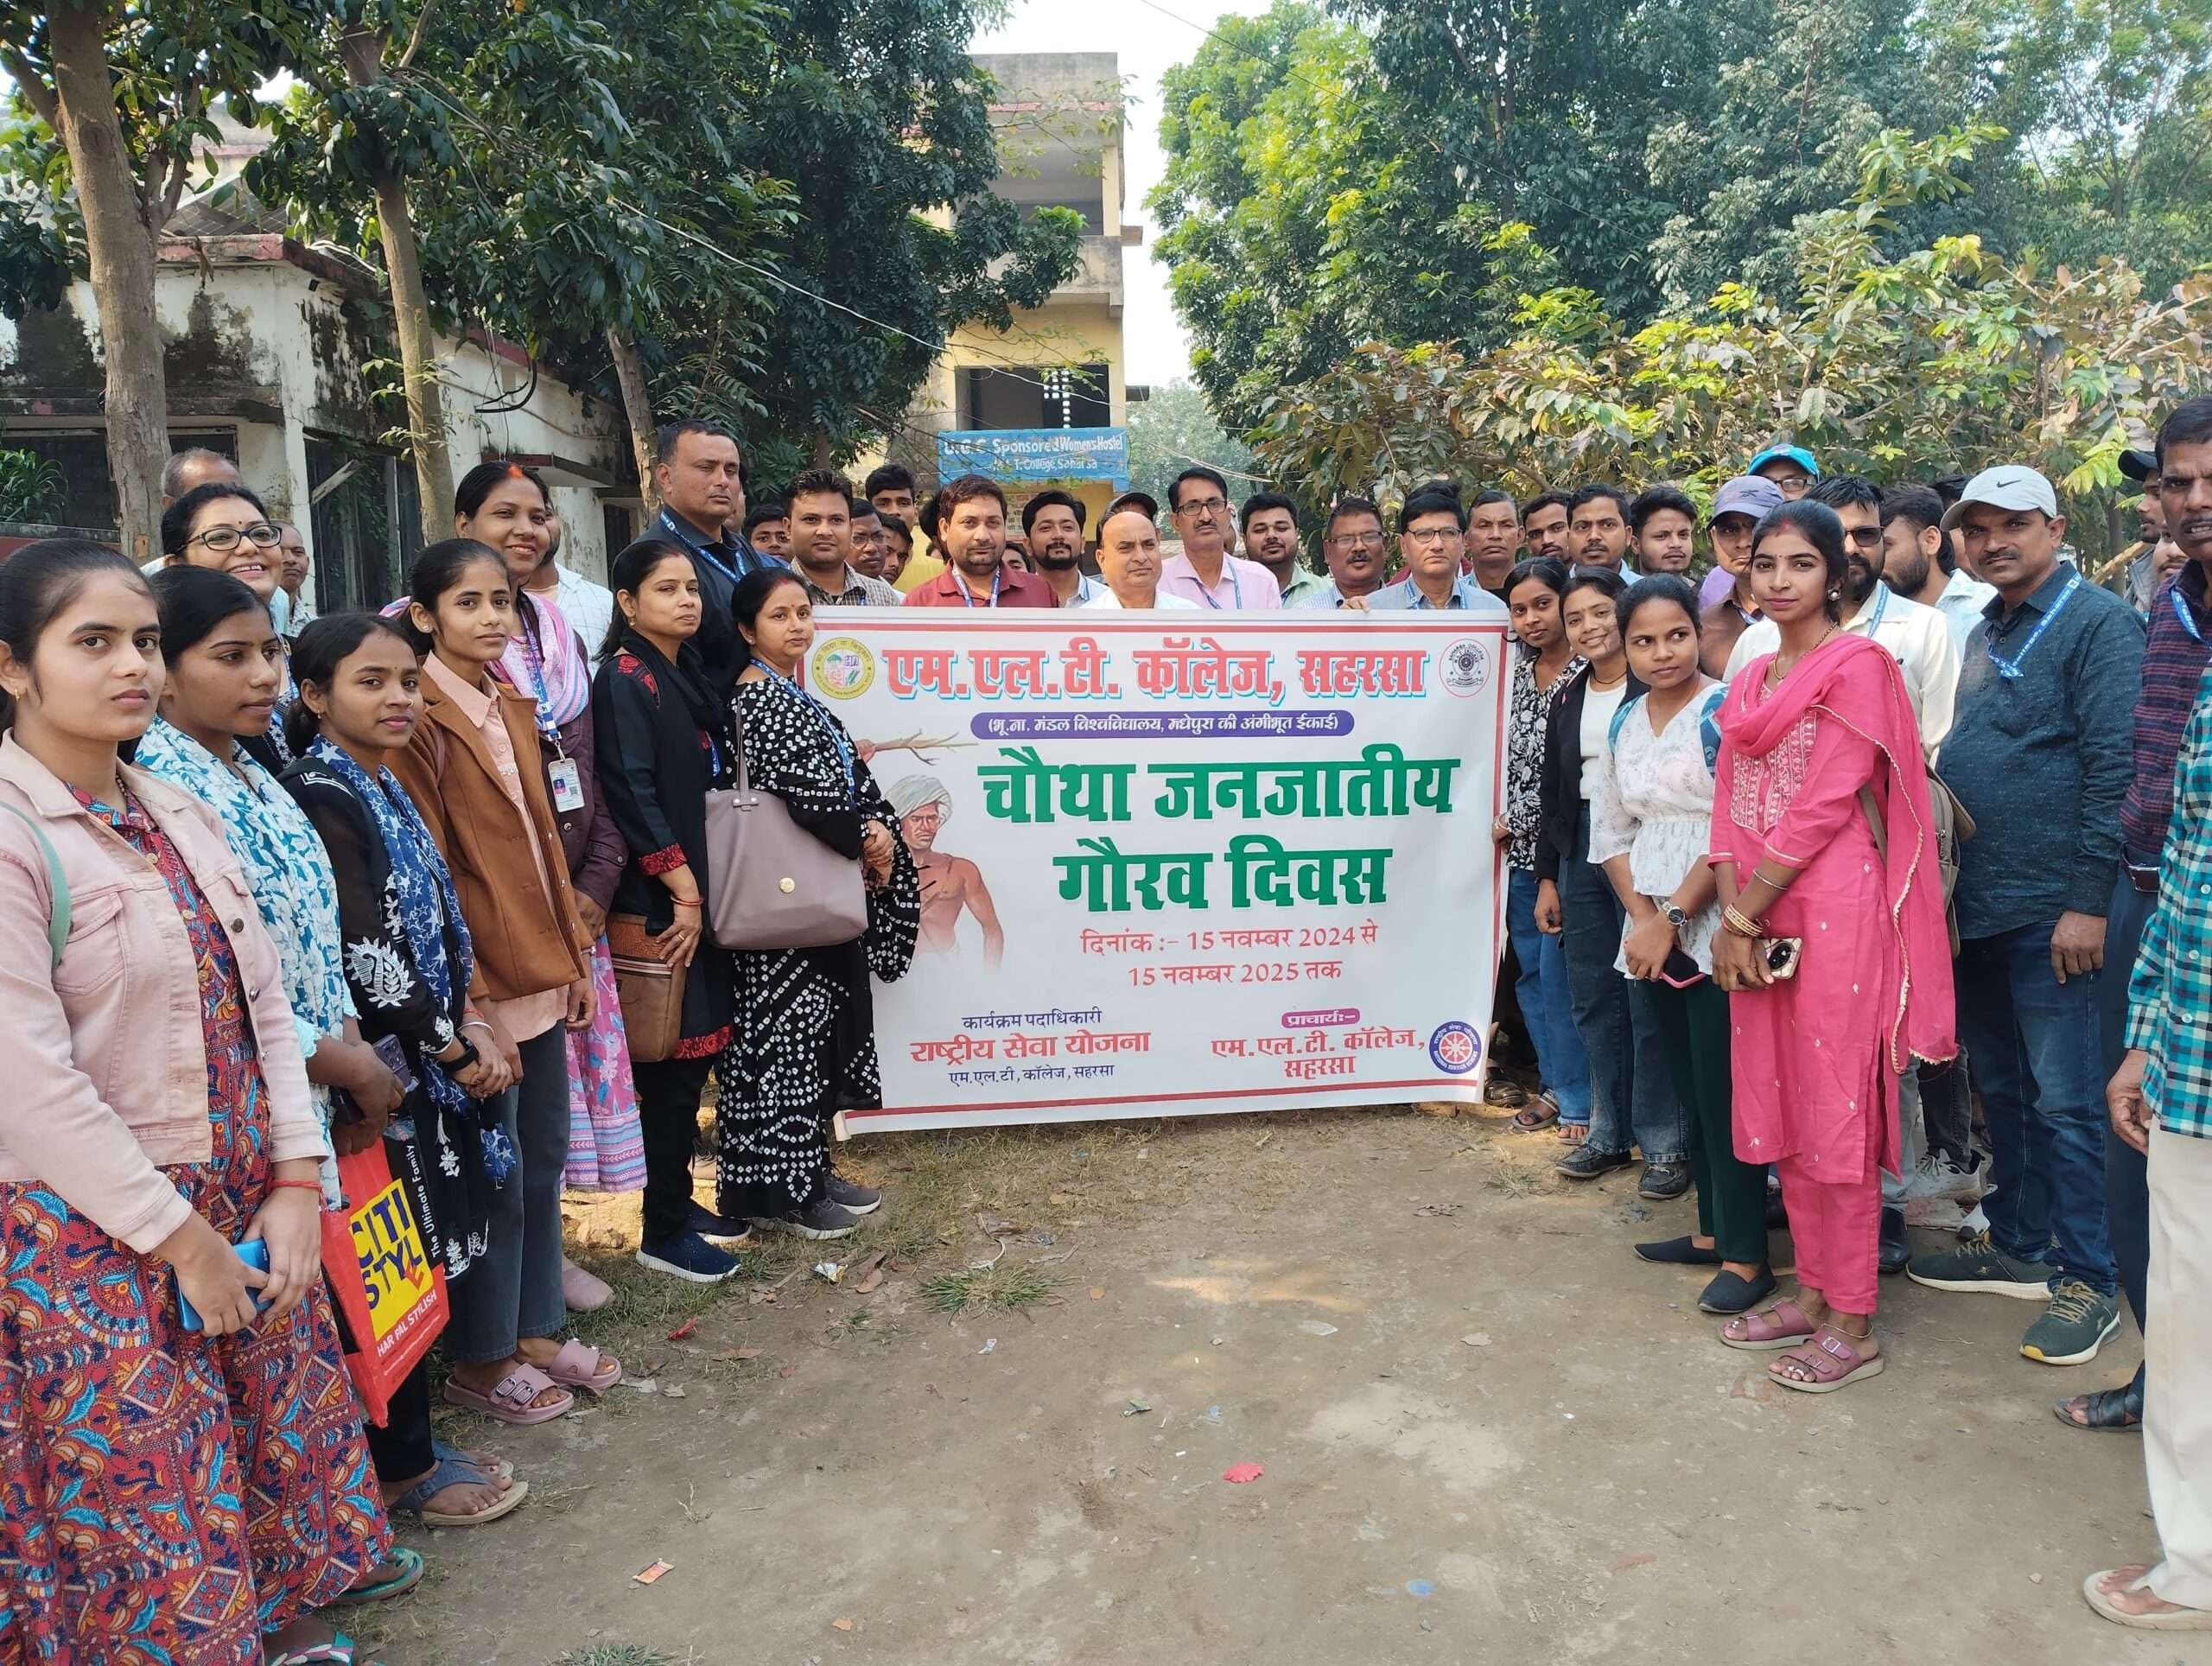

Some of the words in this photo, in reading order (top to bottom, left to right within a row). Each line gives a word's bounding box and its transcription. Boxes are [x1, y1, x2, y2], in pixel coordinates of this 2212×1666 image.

[881, 637, 1122, 700] एम.एल.टी.
[1133, 636, 1286, 707] कॉलेज,
[1296, 650, 1430, 698] सहरसा
[1034, 715, 1071, 731] मंडल
[1073, 714, 1164, 733] विश्वविद्यालय,
[1168, 714, 1214, 734] मधेपुरा
[1217, 713, 1237, 729] की
[1240, 713, 1294, 734] अंगीभूत
[1295, 712, 1338, 730] ईकाई)
[977, 745, 1136, 823] चौथा
[1147, 743, 1461, 821] जनजातीय
[1052, 836, 1214, 912] गौरव
[1224, 834, 1394, 909] दिवस
[1080, 927, 1154, 957] दिनांक
[1187, 931, 1215, 951] 15
[1219, 929, 1294, 949] नवम्बर
[1299, 926, 1356, 948] 2024
[1359, 919, 1379, 946] से
[1128, 967, 1155, 987] 15
[1160, 964, 1236, 986] नवम्बर
[1240, 962, 1299, 983] 2025
[1303, 960, 1344, 981] तक
[962, 1010, 1021, 1030] कार्यक्रम
[1025, 1006, 1103, 1027] पदाधिकारी
[909, 1034, 996, 1065] राष्ट्रीय
[1001, 1032, 1058, 1059] सेवा
[1064, 1028, 1152, 1054] योजना
[1343, 1026, 1425, 1051] कॉलेज,
[1022, 1064, 1071, 1082] कॉलेज,
[1073, 1064, 1115, 1079] सहरसा
[1283, 1056, 1357, 1079] सहरसा
[406, 1144, 422, 1183] Family
[352, 1188, 410, 1269] CITI
[417, 1185, 435, 1235] Ultimate
[430, 1235, 442, 1258] The
[377, 1334, 395, 1358] HAR
[394, 1320, 409, 1340] PAL
